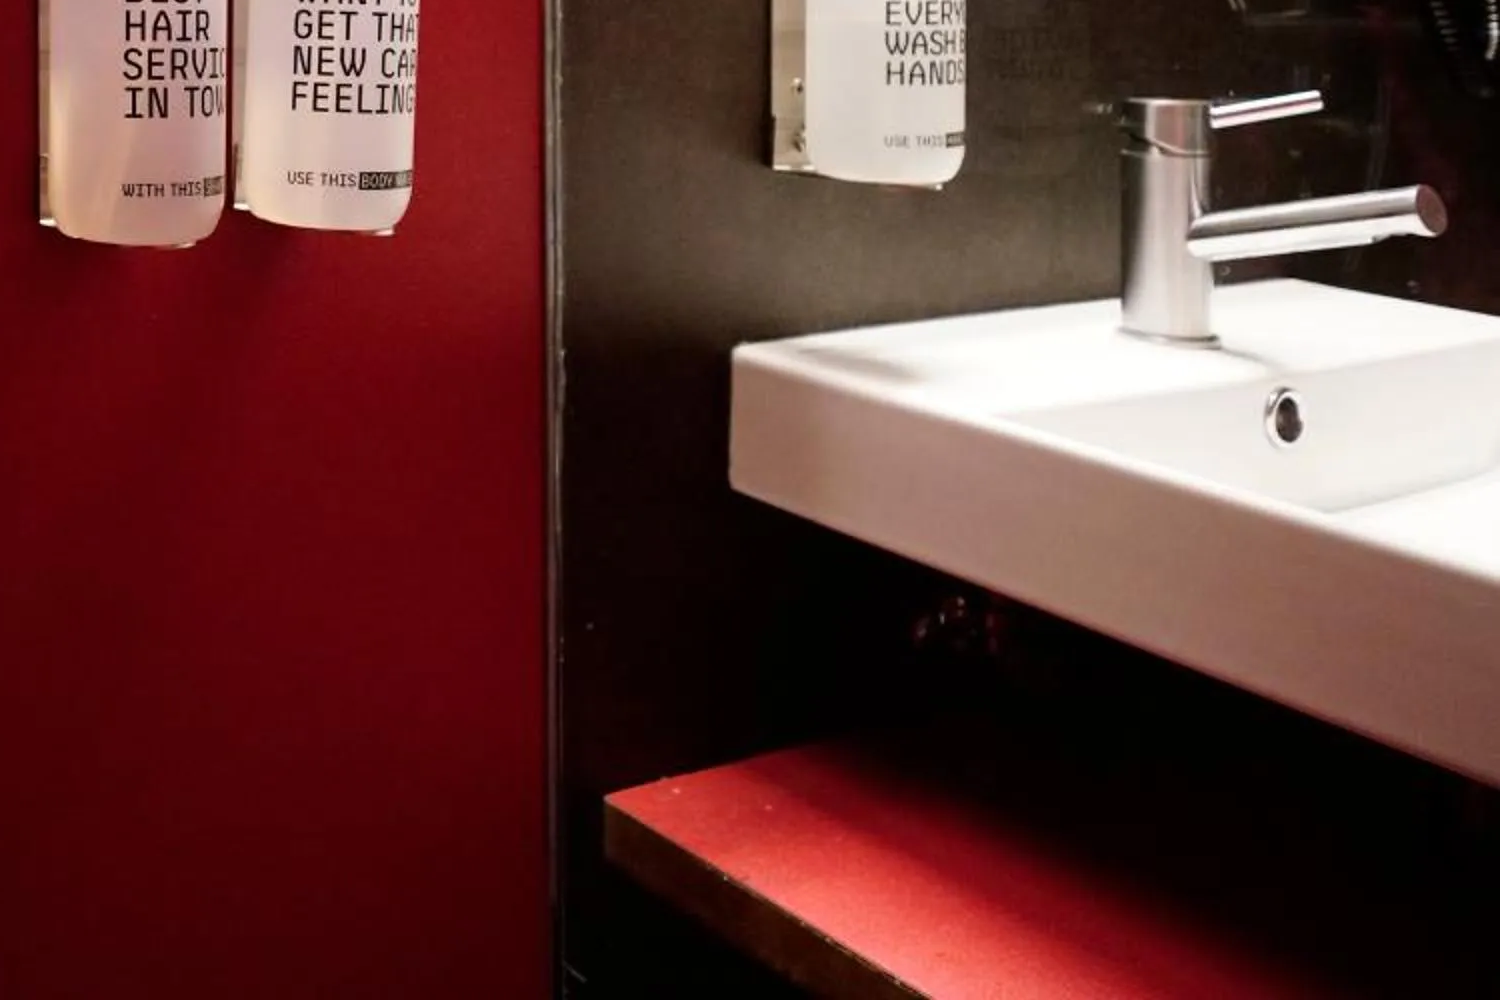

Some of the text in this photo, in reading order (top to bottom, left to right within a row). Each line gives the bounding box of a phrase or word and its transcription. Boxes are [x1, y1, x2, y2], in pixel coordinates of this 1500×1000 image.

[125, 9, 209, 41] HAIR
[293, 9, 419, 42] GET THA
[885, 0, 966, 25] EVERY
[884, 29, 957, 55] WASH
[293, 45, 366, 77] NEW
[886, 58, 965, 86] HANDS
[124, 87, 169, 118] IN
[291, 81, 415, 115] FEELING
[121, 183, 165, 197] WITH
[171, 181, 201, 197] THIS
[287, 172, 314, 185] USE
[320, 173, 357, 187] THIS
[361, 173, 393, 189] BODY
